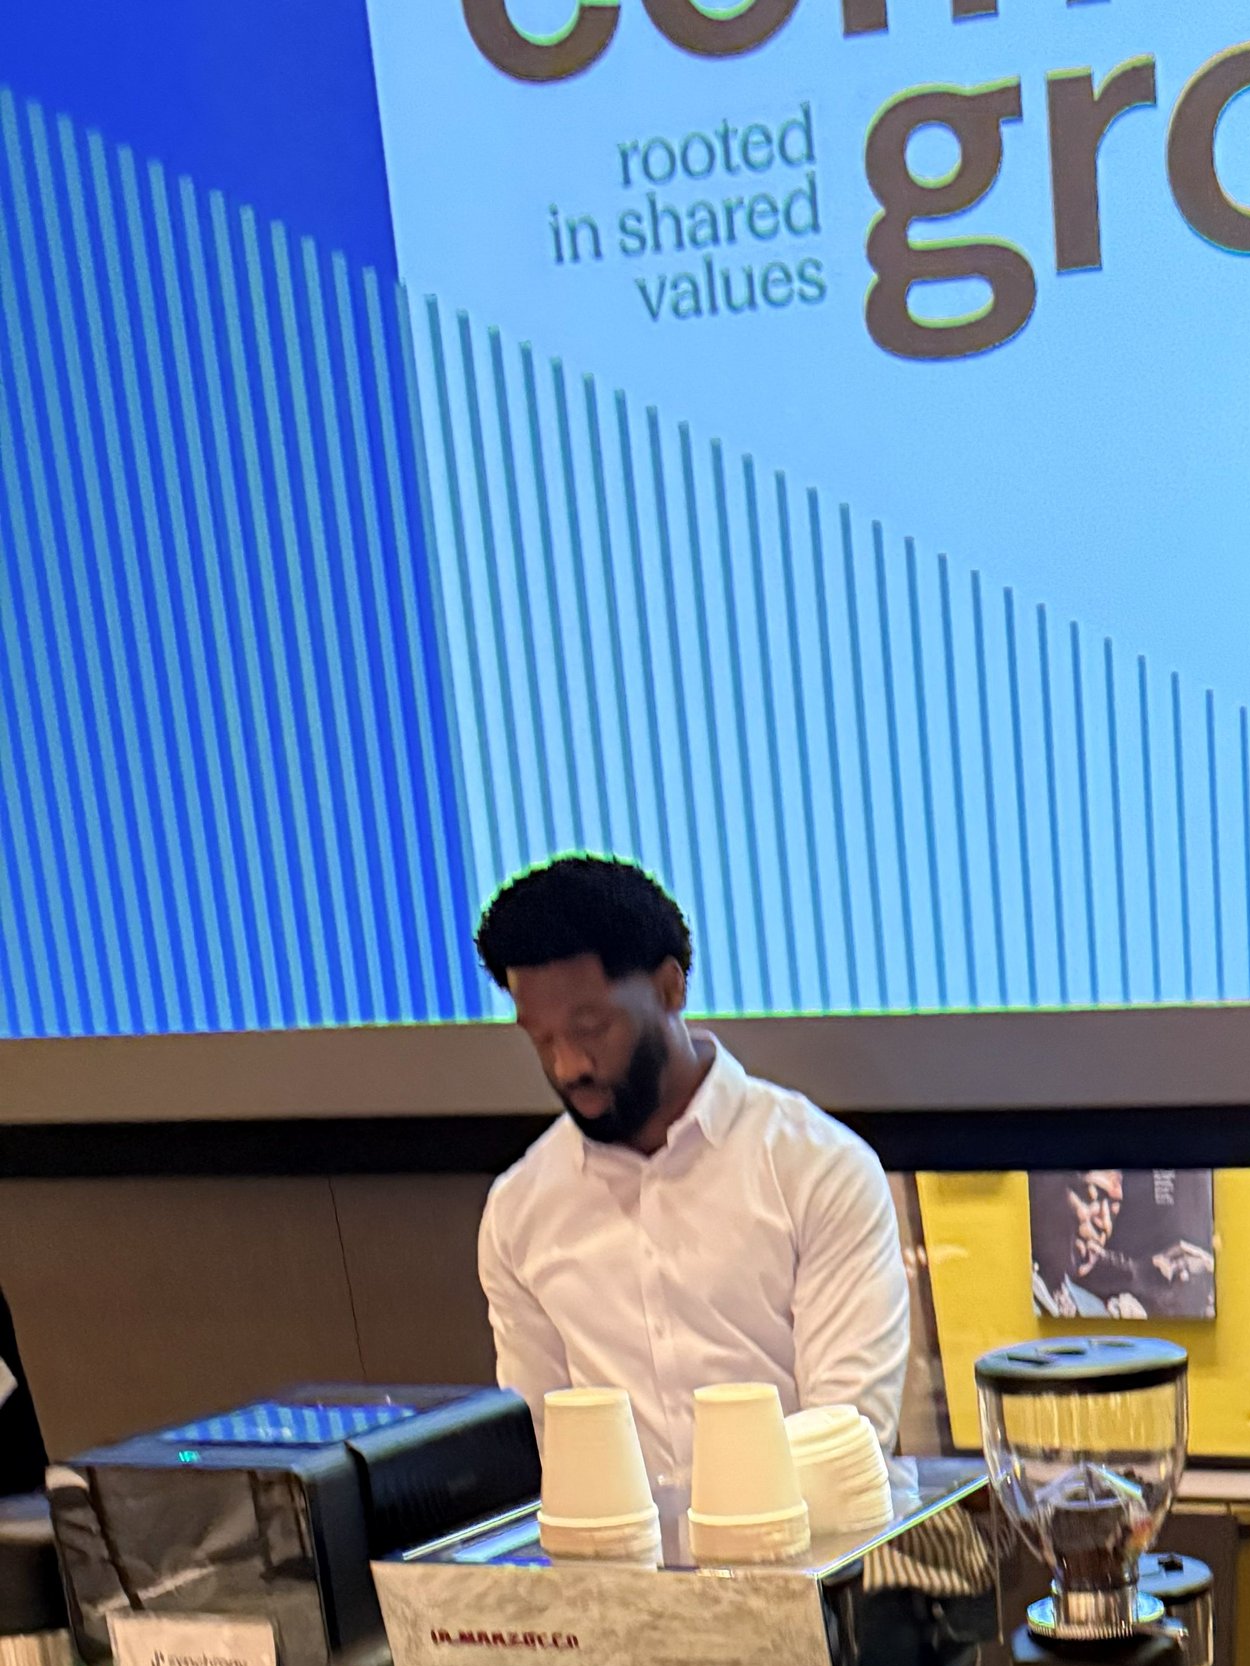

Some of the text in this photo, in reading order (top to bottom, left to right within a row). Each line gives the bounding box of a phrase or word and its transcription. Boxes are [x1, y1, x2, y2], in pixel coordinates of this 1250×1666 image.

[616, 100, 816, 189] rooted
[549, 169, 821, 265] in shared
[634, 252, 827, 323] values
